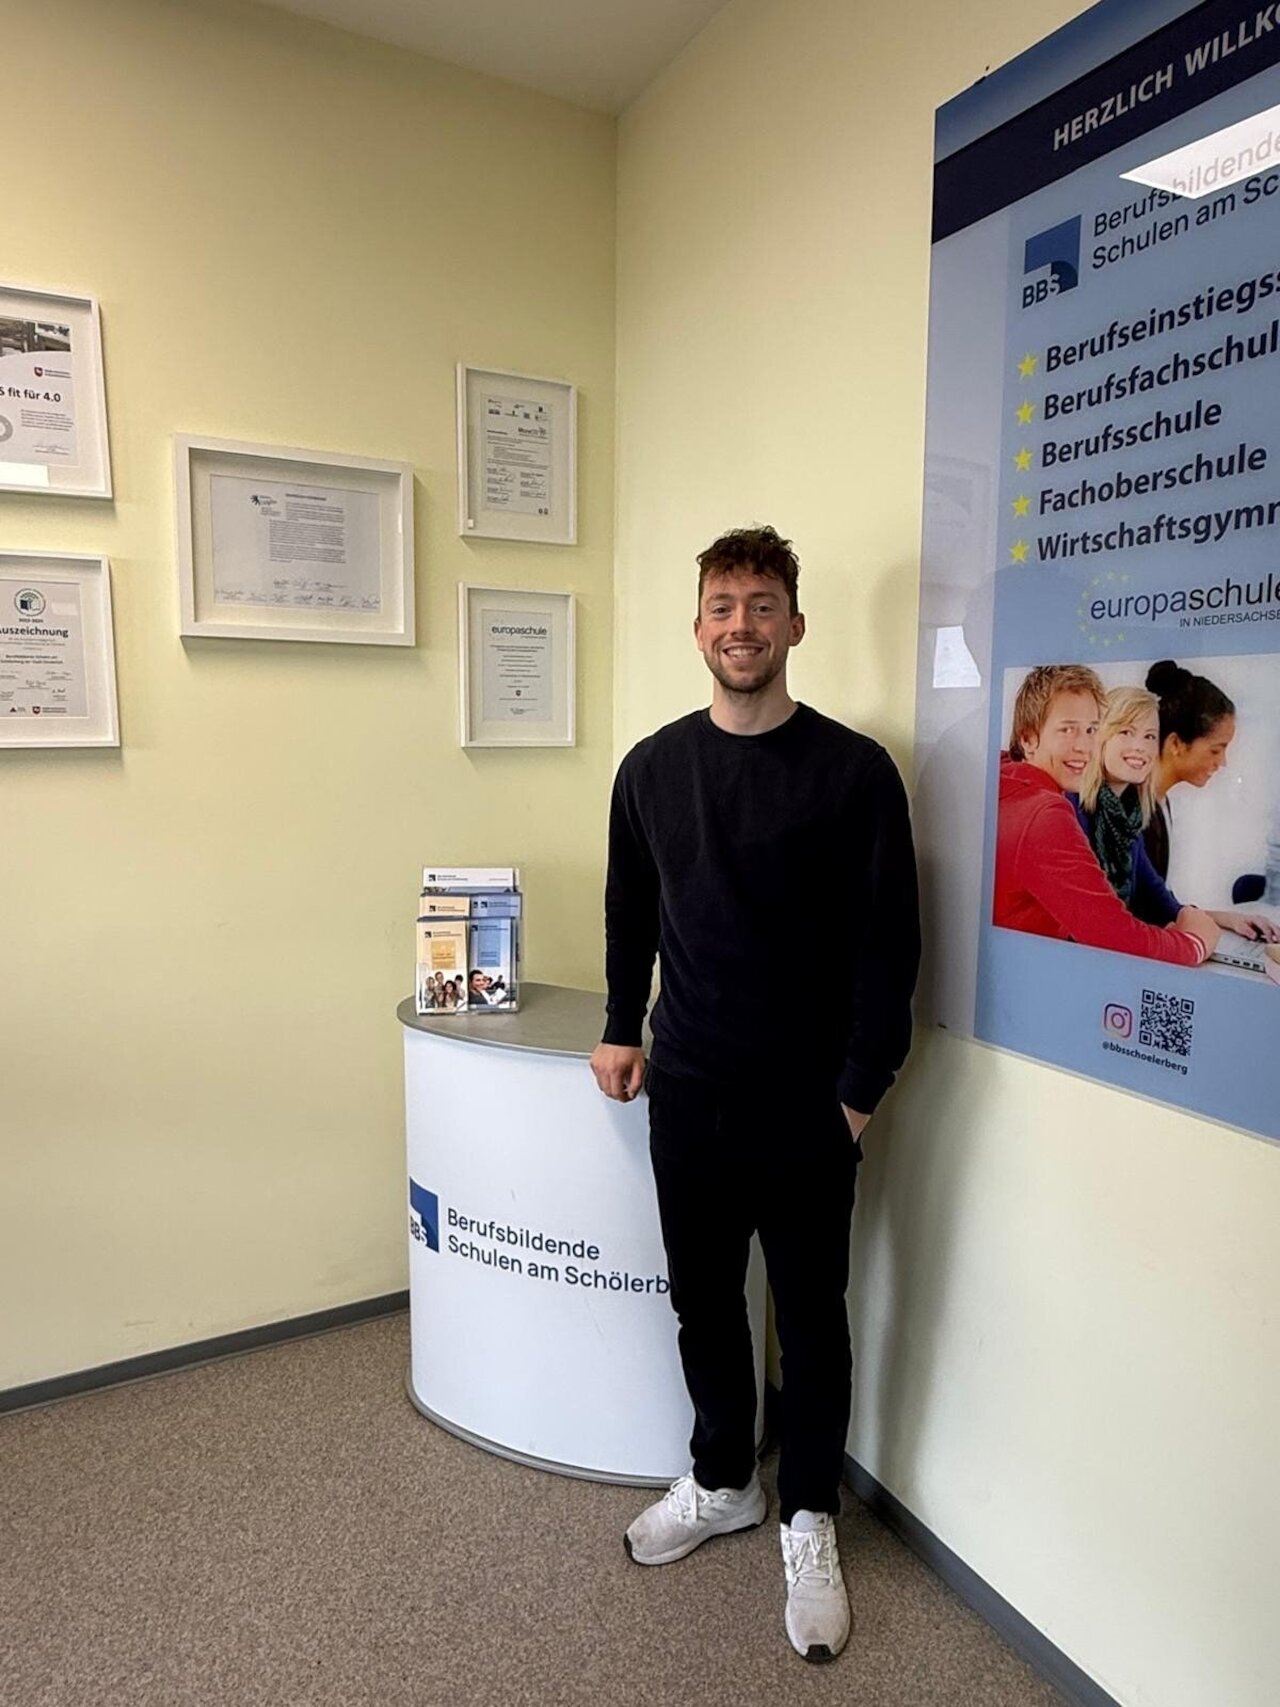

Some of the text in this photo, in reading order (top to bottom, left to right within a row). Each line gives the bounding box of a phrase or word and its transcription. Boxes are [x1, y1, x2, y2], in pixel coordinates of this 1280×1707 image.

[1053, 3, 1280, 151] HERZLICH WILLK
[1092, 213, 1189, 270] Schulen
[1195, 192, 1235, 227] am
[1022, 273, 1061, 309] BBS
[1045, 271, 1280, 373] Berufseinstiegs
[8, 387, 21, 398] fit
[24, 389, 40, 400] für
[43, 392, 61, 402] 4.0
[1043, 319, 1279, 420] Berufsfachschul
[1041, 399, 1222, 467] Berufsschule
[1039, 443, 1267, 515] Fachoberschule
[0, 626, 69, 638] uszeichnung
[491, 625, 547, 636] europaschule
[1179, 617, 1190, 628] IN
[1102, 1041, 1188, 1075] @bbsschoelerberg
[448, 1207, 600, 1260] Berufsbildende
[448, 1235, 670, 1294] Schulen am Schölerb
